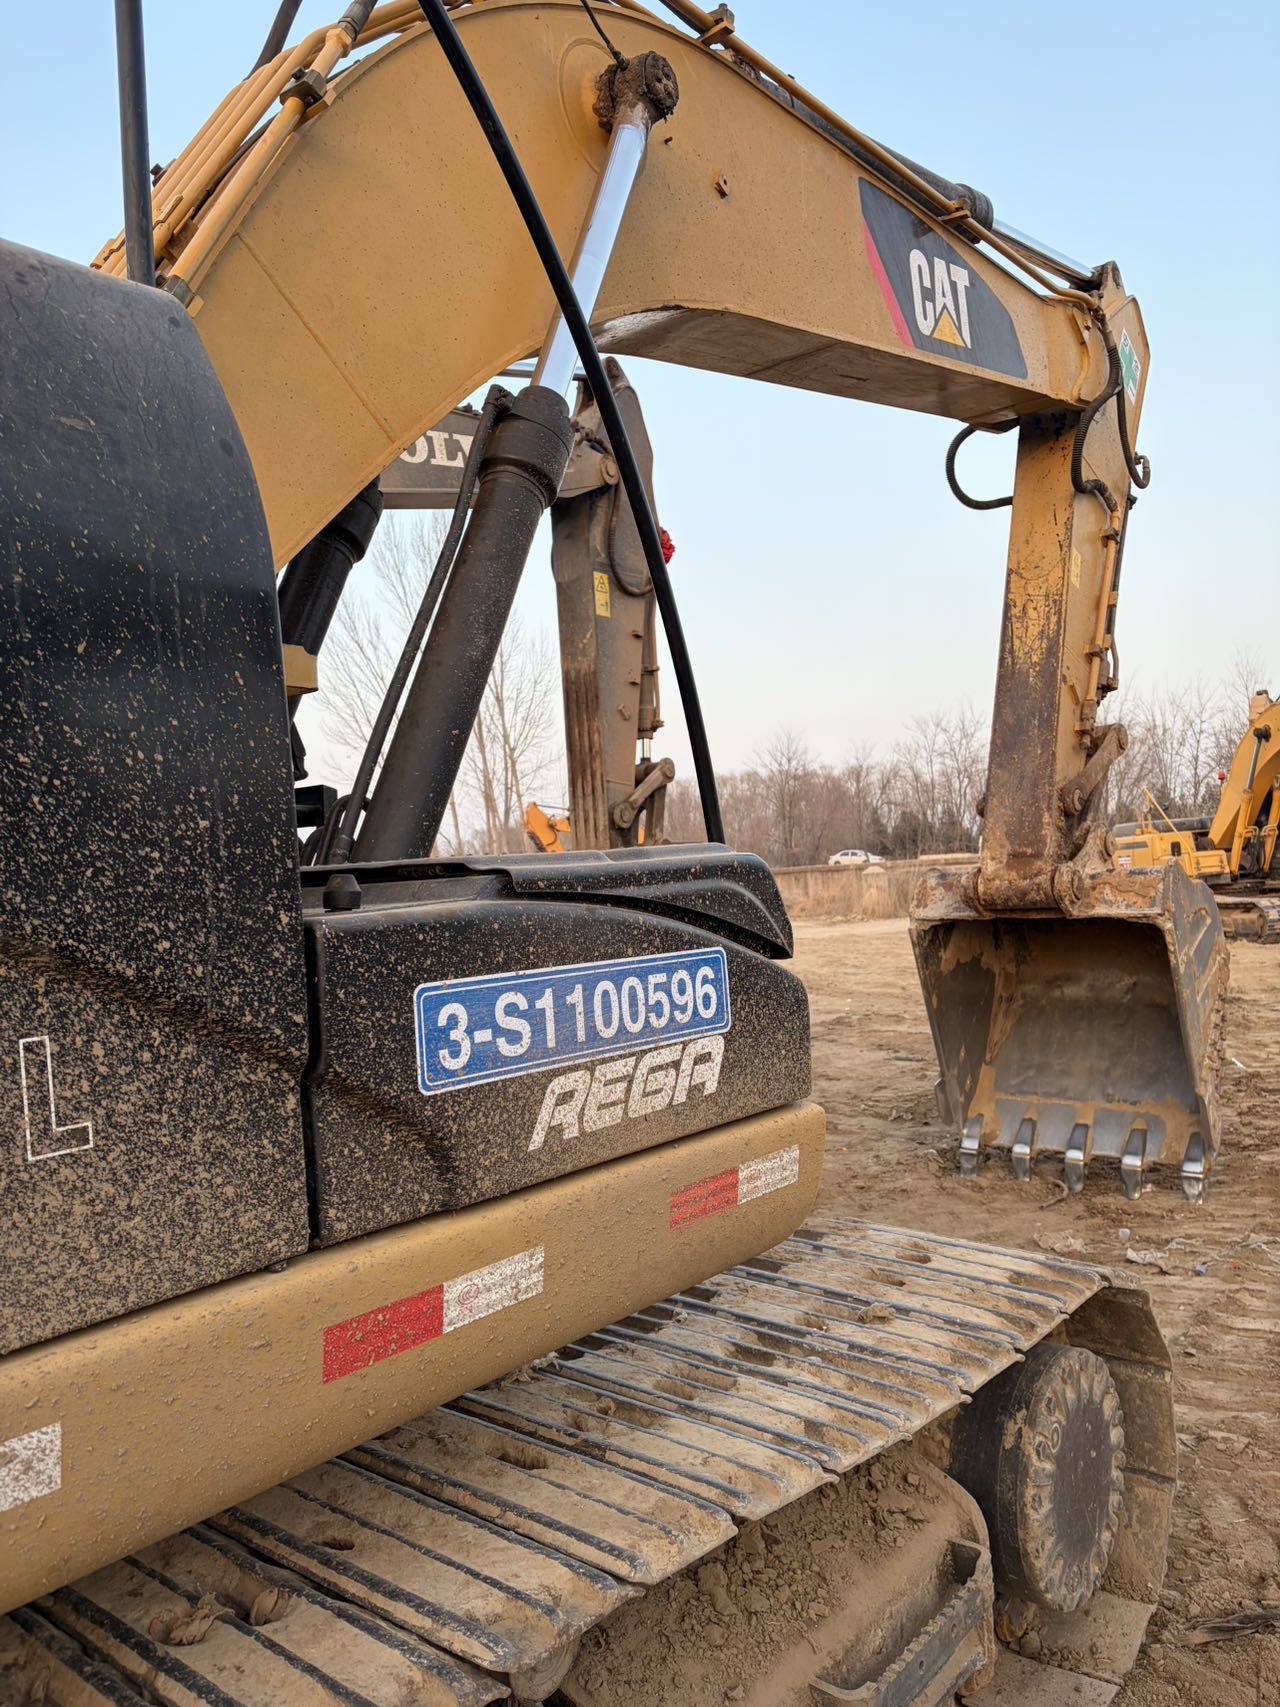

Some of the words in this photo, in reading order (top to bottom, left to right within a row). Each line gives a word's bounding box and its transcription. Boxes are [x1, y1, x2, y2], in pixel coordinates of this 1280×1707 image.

[909, 249, 971, 349] CAT
[437, 966, 718, 1071] 3-S1100596
[528, 1035, 725, 1151] REGA
